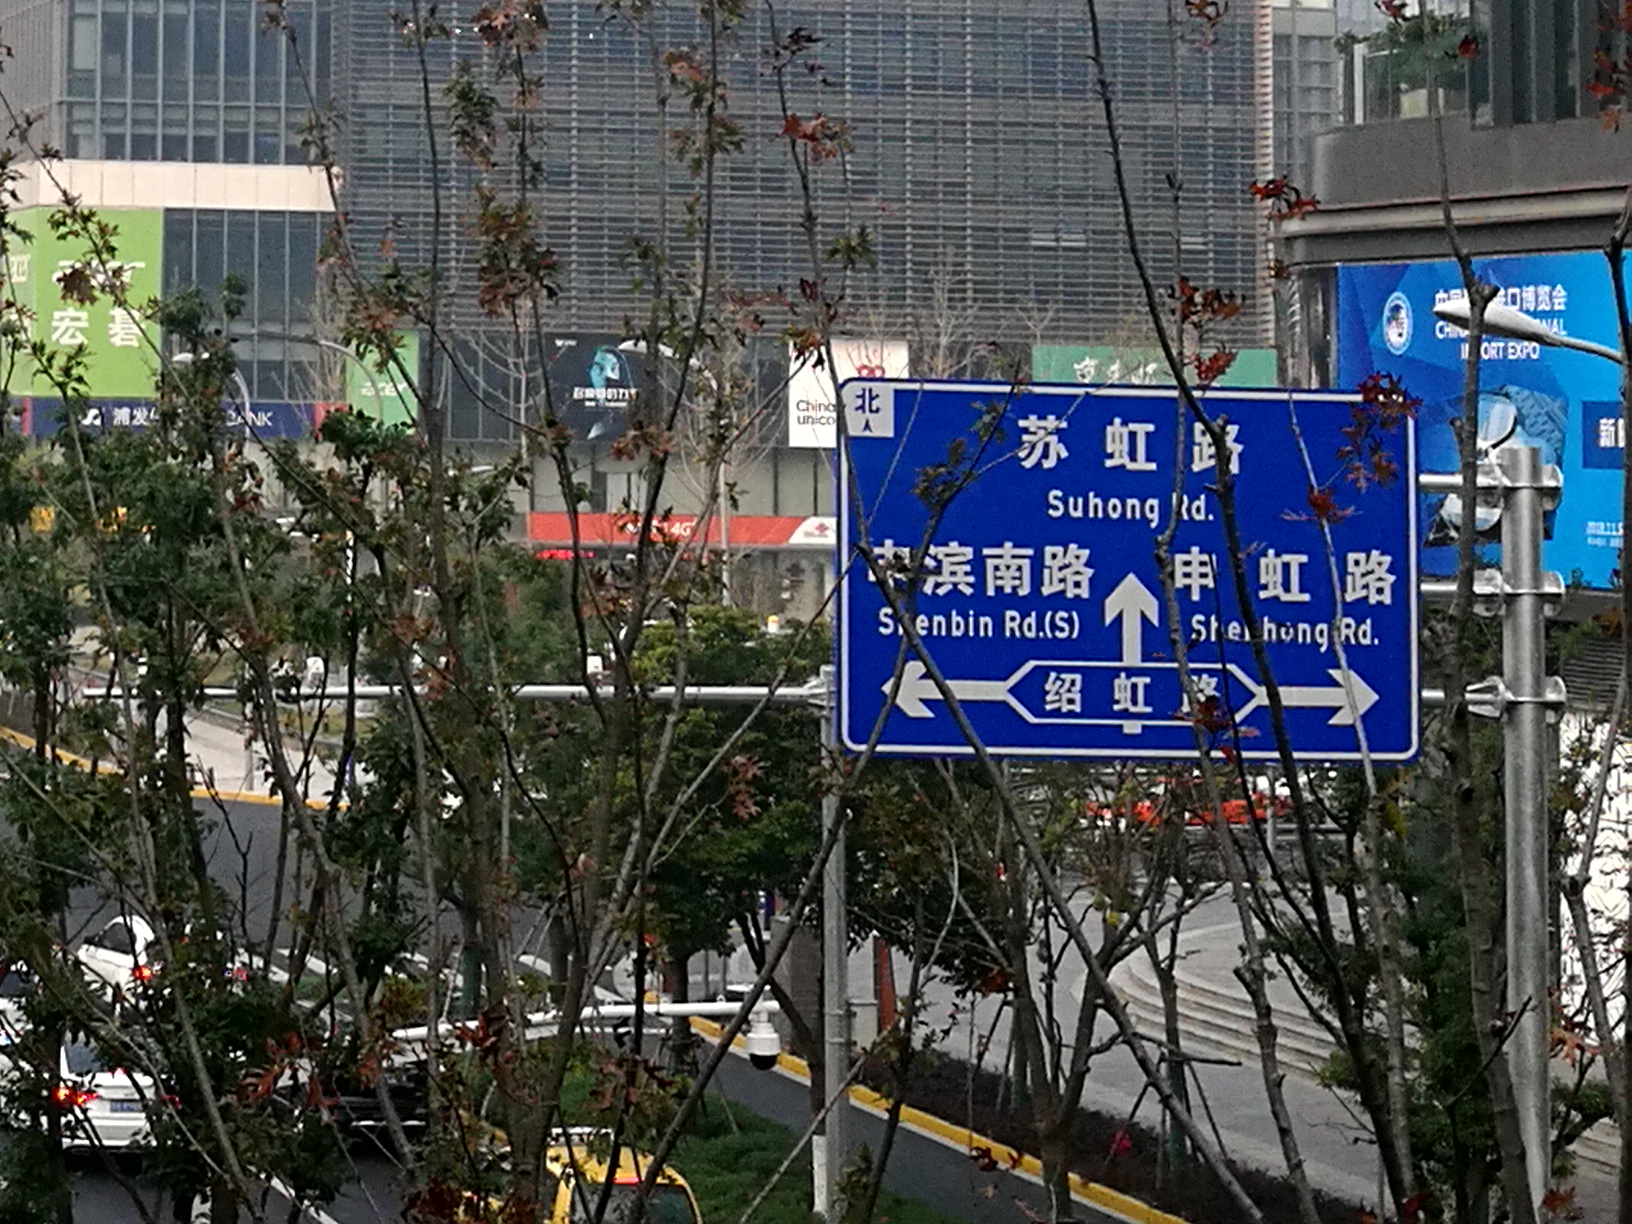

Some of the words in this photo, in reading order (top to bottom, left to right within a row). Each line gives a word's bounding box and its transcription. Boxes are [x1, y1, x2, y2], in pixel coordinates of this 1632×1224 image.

[1461, 342, 1504, 360] IORT
[1507, 342, 1540, 360] EXPO
[854, 387, 881, 414] 北
[796, 414, 837, 427] unico
[1017, 414, 1246, 475] 苏虹路
[1047, 489, 1160, 530] Suhong
[1173, 545, 1397, 605] 申虹路
[877, 606, 994, 638] Senbin
[1004, 609, 1080, 639] Rd.(S)
[1339, 617, 1380, 646] Rd.
